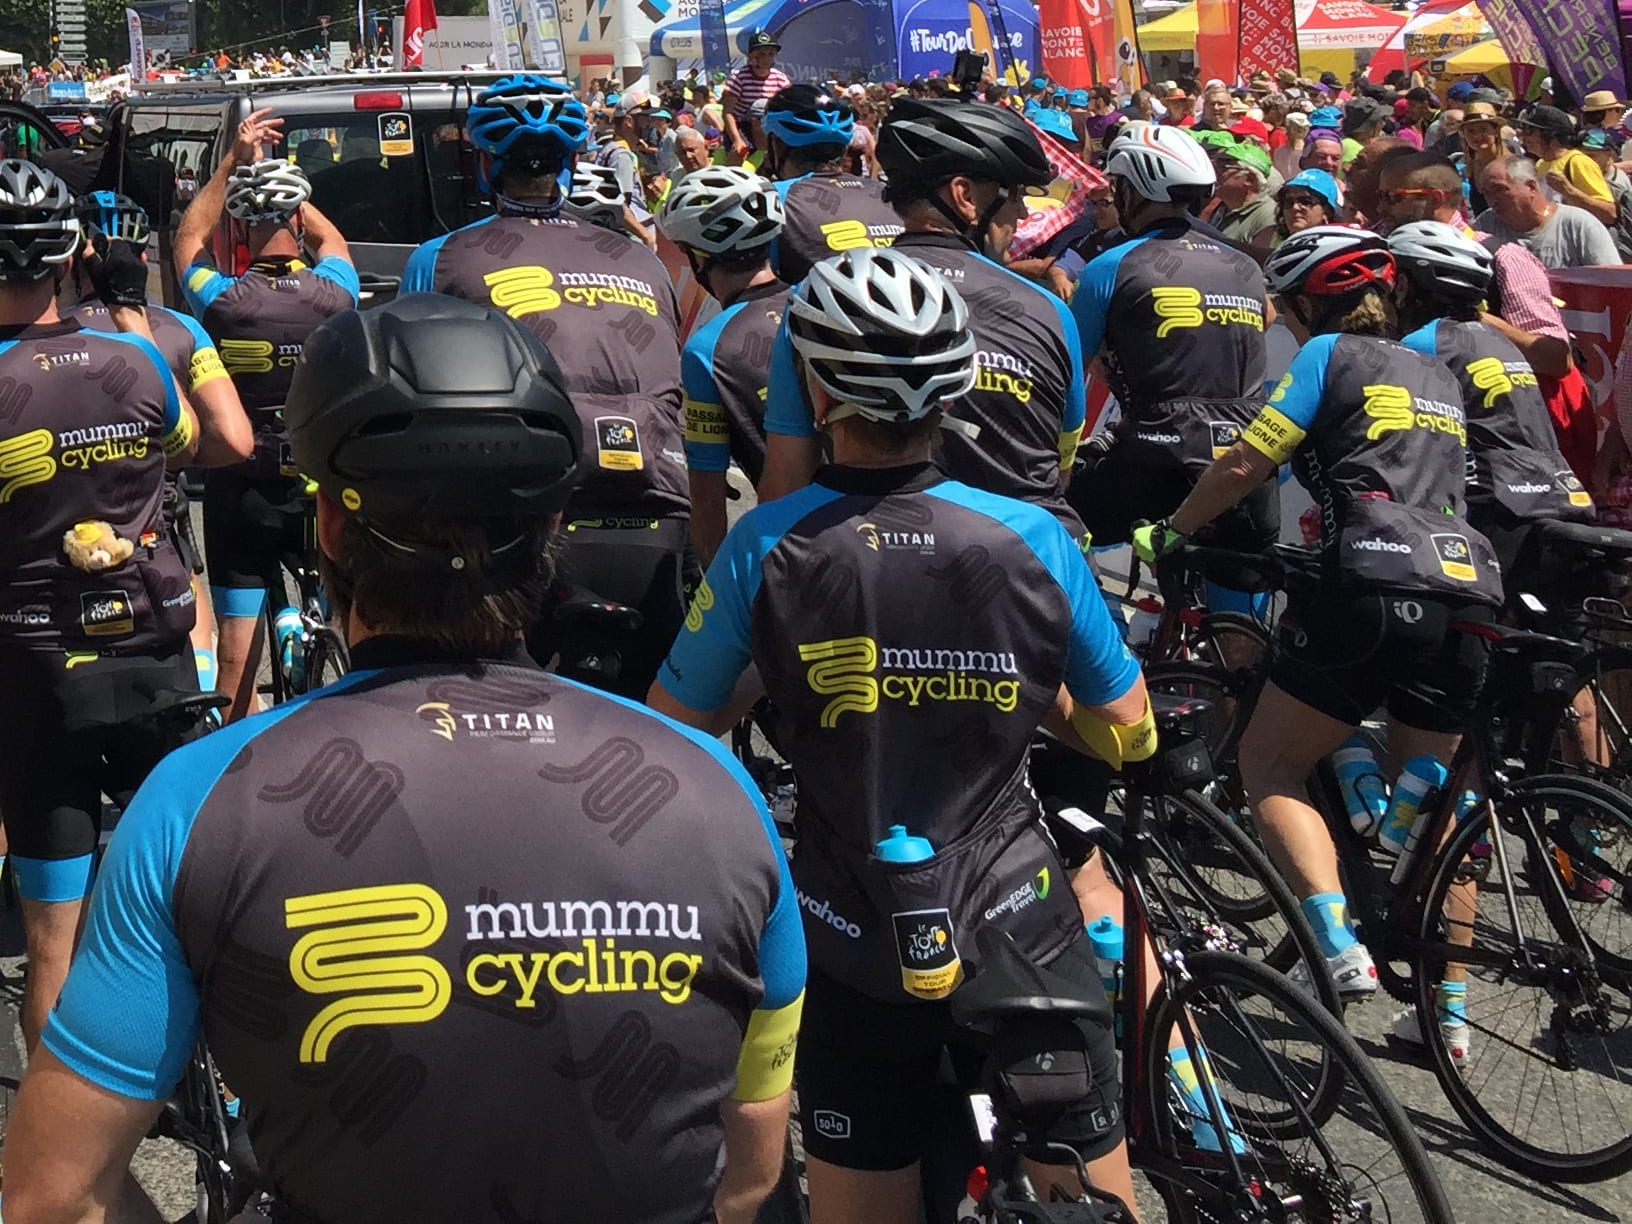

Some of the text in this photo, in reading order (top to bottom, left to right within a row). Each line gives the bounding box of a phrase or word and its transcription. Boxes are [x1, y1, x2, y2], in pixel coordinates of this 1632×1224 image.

[559, 270, 655, 297] mummu
[564, 286, 659, 317] cycling
[50, 352, 90, 366] TITAN
[60, 436, 151, 470] cycling
[1507, 482, 1552, 494] wahoo
[881, 532, 936, 546] TITAN
[1350, 537, 1413, 556] wahoo
[881, 646, 1019, 675] mummu
[881, 670, 1020, 713] cycling
[461, 713, 554, 730] TITAN
[983, 881, 1034, 921] GreenEDGE
[465, 899, 703, 942] mummu
[466, 937, 704, 1009] cycling
[818, 1116, 844, 1133] solo
